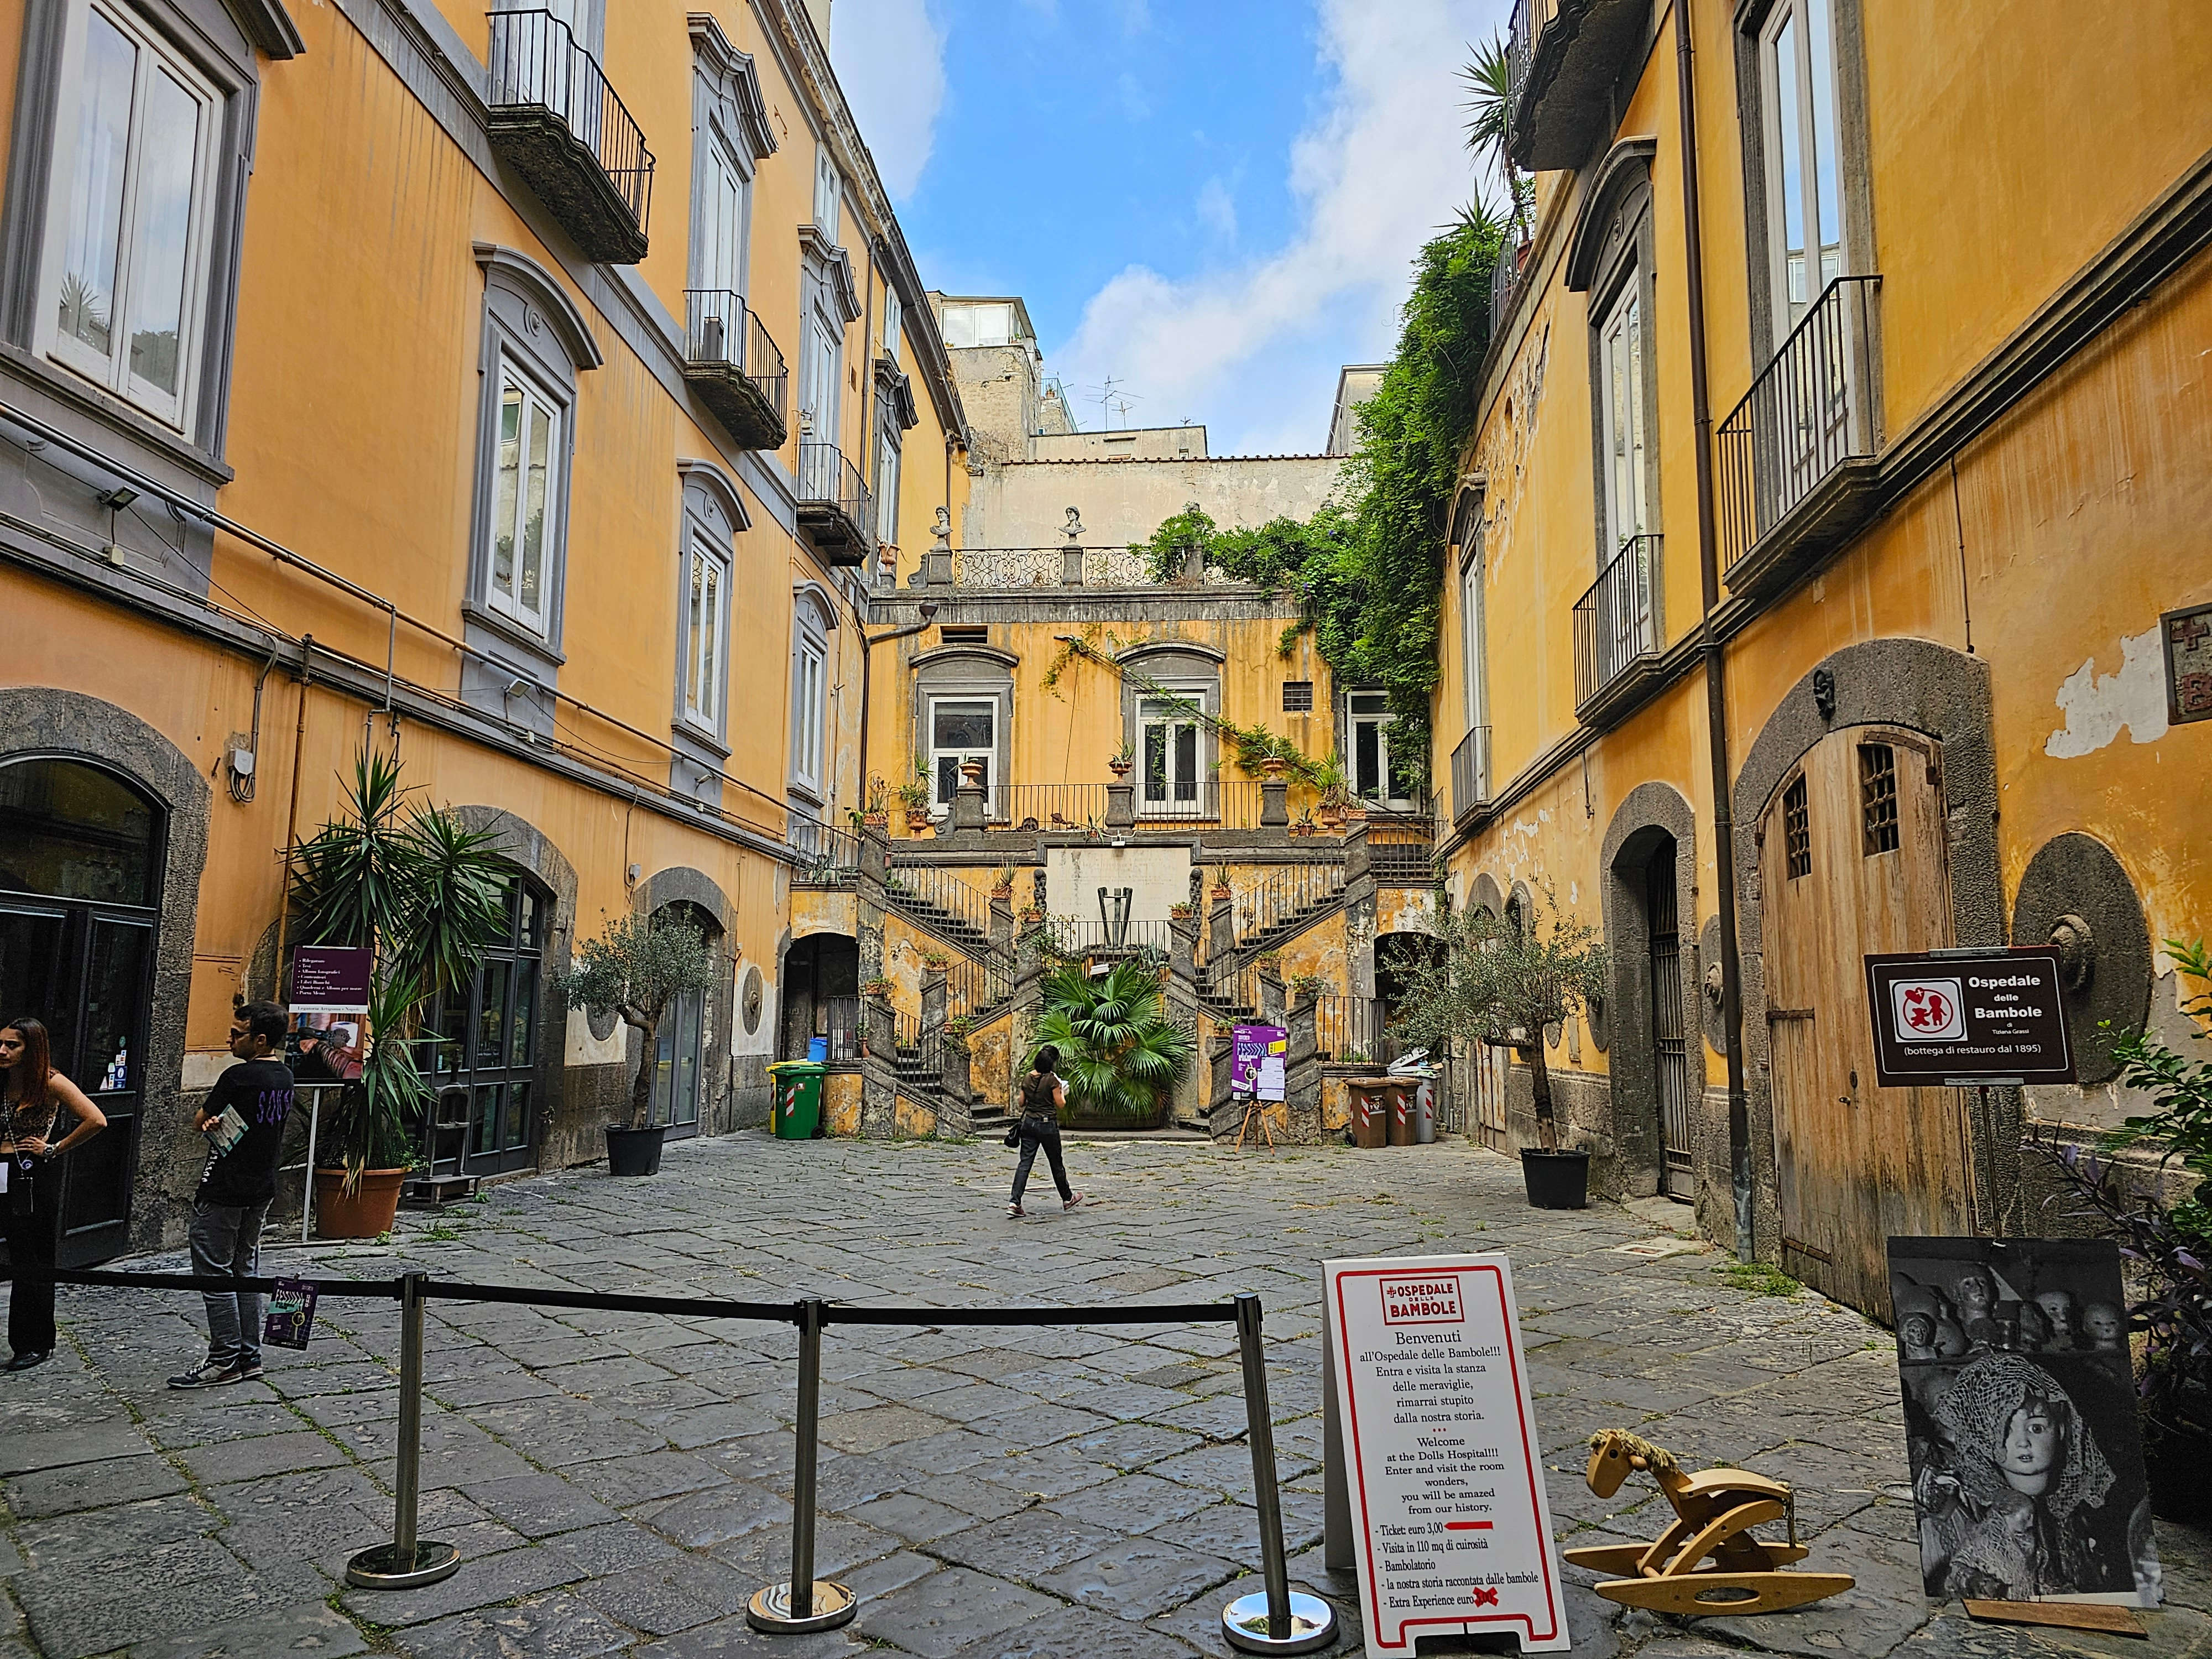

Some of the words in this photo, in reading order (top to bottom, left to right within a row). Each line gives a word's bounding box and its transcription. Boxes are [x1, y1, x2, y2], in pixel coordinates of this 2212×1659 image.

[1968, 975, 2041, 989] Ospedale
[1975, 1006, 2042, 1019] Bambole
[1904, 1046, 1944, 1057] (bottega
[1945, 1045, 1955, 1055] di
[1997, 1045, 2012, 1053] dal
[2014, 1044, 2042, 1054] 1895)
[1397, 1284, 1453, 1297] OSPEDALE
[1390, 1301, 1456, 1317] BAMBOLE
[1395, 1330, 1462, 1344] Benvenuti
[1421, 1348, 1444, 1359] delle
[1448, 1346, 1501, 1358] Bambole!!!
[1376, 1366, 1404, 1376] Entra
[1415, 1365, 1441, 1375] visita
[1443, 1364, 1453, 1374] la
[1456, 1364, 1486, 1373] stanza
[1392, 1381, 1416, 1392] delle
[1420, 1379, 1473, 1391] meraviglie,
[1396, 1396, 1438, 1407] rimarrai
[1441, 1395, 1474, 1407] stupito
[1394, 1413, 1418, 1423] dalla
[1421, 1412, 1452, 1422] nostra
[1454, 1410, 1485, 1421] storia.
[1417, 1437, 1465, 1447] Welcome
[1399, 1452, 1415, 1461] the
[1418, 1451, 1444, 1460] Dolls
[1447, 1448, 1499, 1460] Hospital!!!
[1385, 1466, 1412, 1475] Enter
[1416, 1464, 1433, 1473] and
[1437, 1464, 1458, 1473] visit
[1460, 1463, 1476, 1472] the
[1425, 1477, 1468, 1486] wonders,
[1401, 1494, 1419, 1503] you
[1422, 1490, 1441, 1500] will
[1444, 1490, 1455, 1499] be
[1459, 1488, 1495, 1499] amazed
[1408, 1505, 1432, 1514] from
[1455, 1503, 1492, 1513] history.
[1380, 1524, 1406, 1536] Ticket:
[1427, 1522, 1443, 1536] 3,00
[1382, 1542, 1405, 1553] Visita
[1406, 1542, 1415, 1553] in
[1417, 1540, 1429, 1552] 110
[1431, 1543, 1444, 1553] mq
[1446, 1539, 1454, 1550] di
[1455, 1538, 1488, 1550] cuirosità
[1385, 1558, 1436, 1572] Bambolatorio
[1386, 1578, 1395, 1590] la
[1396, 1578, 1420, 1590] nostra
[1422, 1576, 1443, 1588] storia
[1445, 1575, 1484, 1587] raccontata
[1485, 1573, 1505, 1585] dalle
[1505, 1571, 1538, 1584] bambole
[1389, 1596, 1411, 1608] Extra
[1412, 1594, 1455, 1609] Experience
[1457, 1596, 1474, 1604] euro
